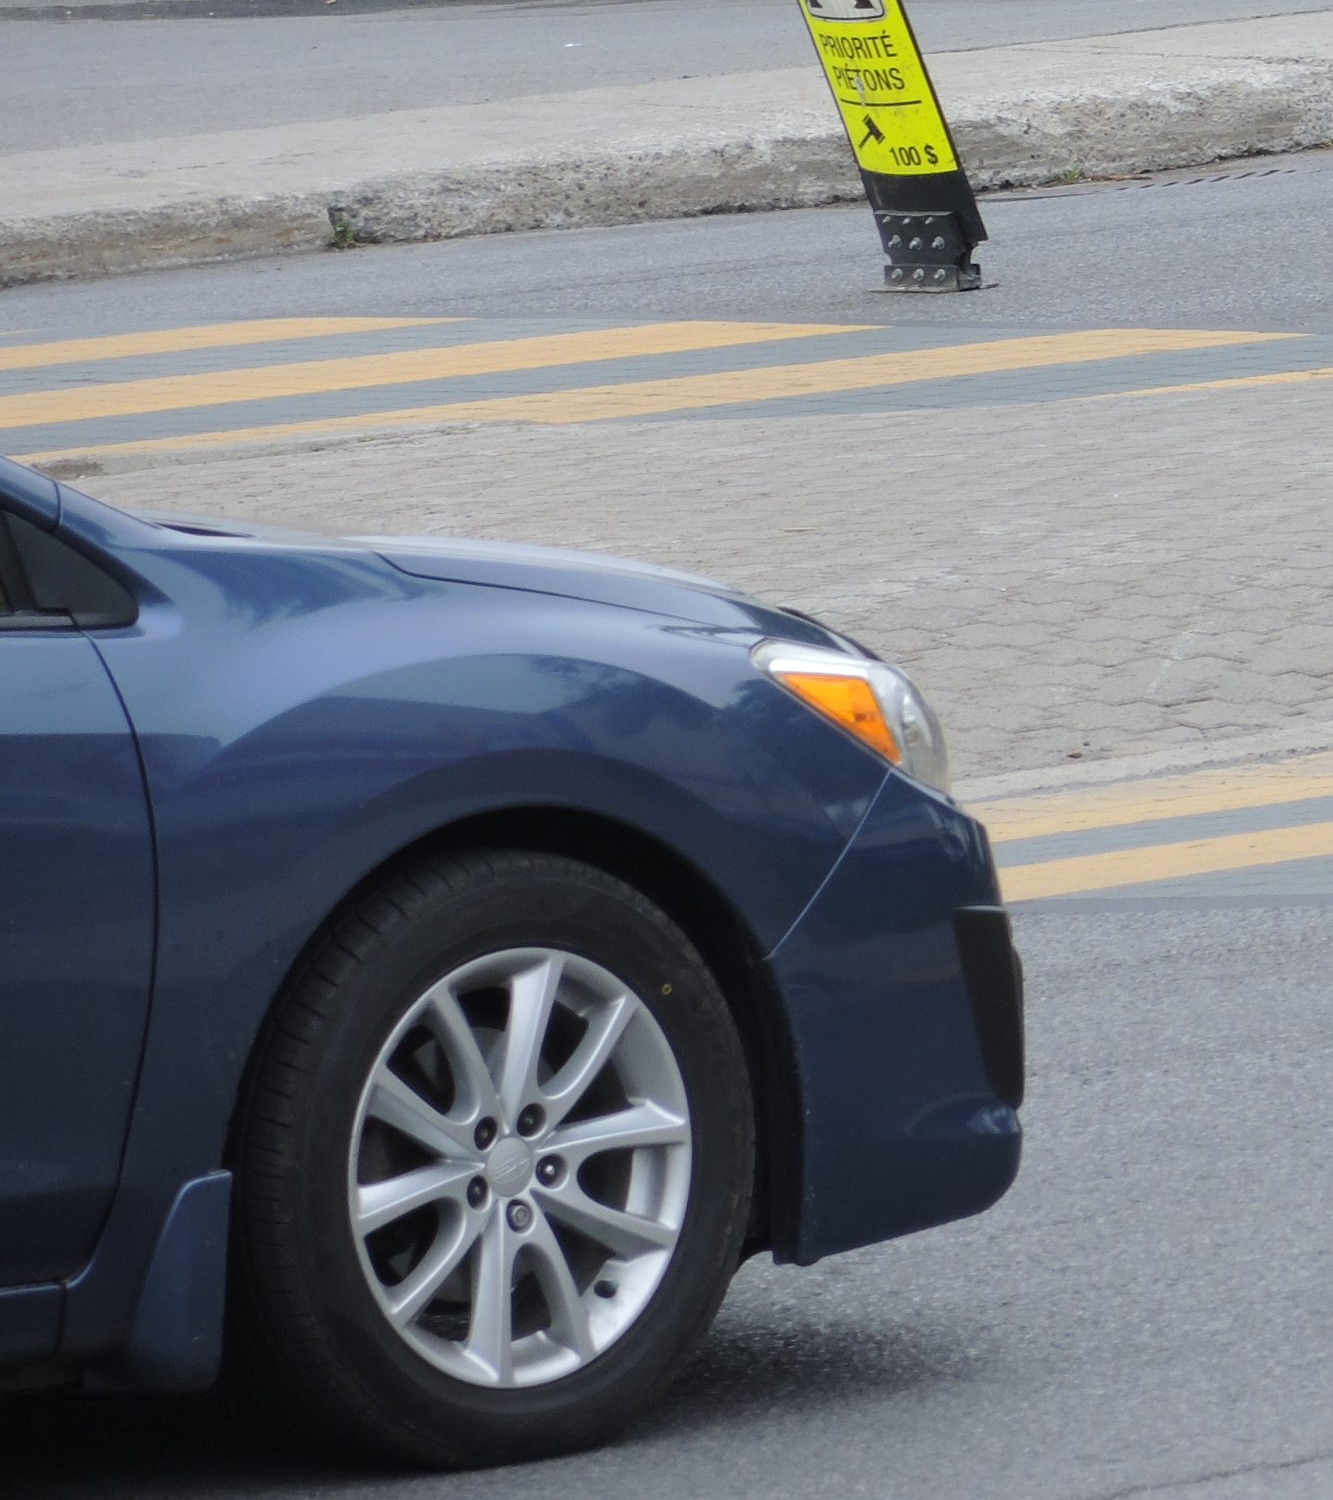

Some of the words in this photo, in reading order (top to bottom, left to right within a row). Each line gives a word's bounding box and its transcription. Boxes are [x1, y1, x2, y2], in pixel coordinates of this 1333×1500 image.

[819, 30, 898, 60] PRIORITÉ
[833, 63, 905, 92] PIÉTONS
[889, 146, 922, 167] 100
[925, 144, 939, 167] $
